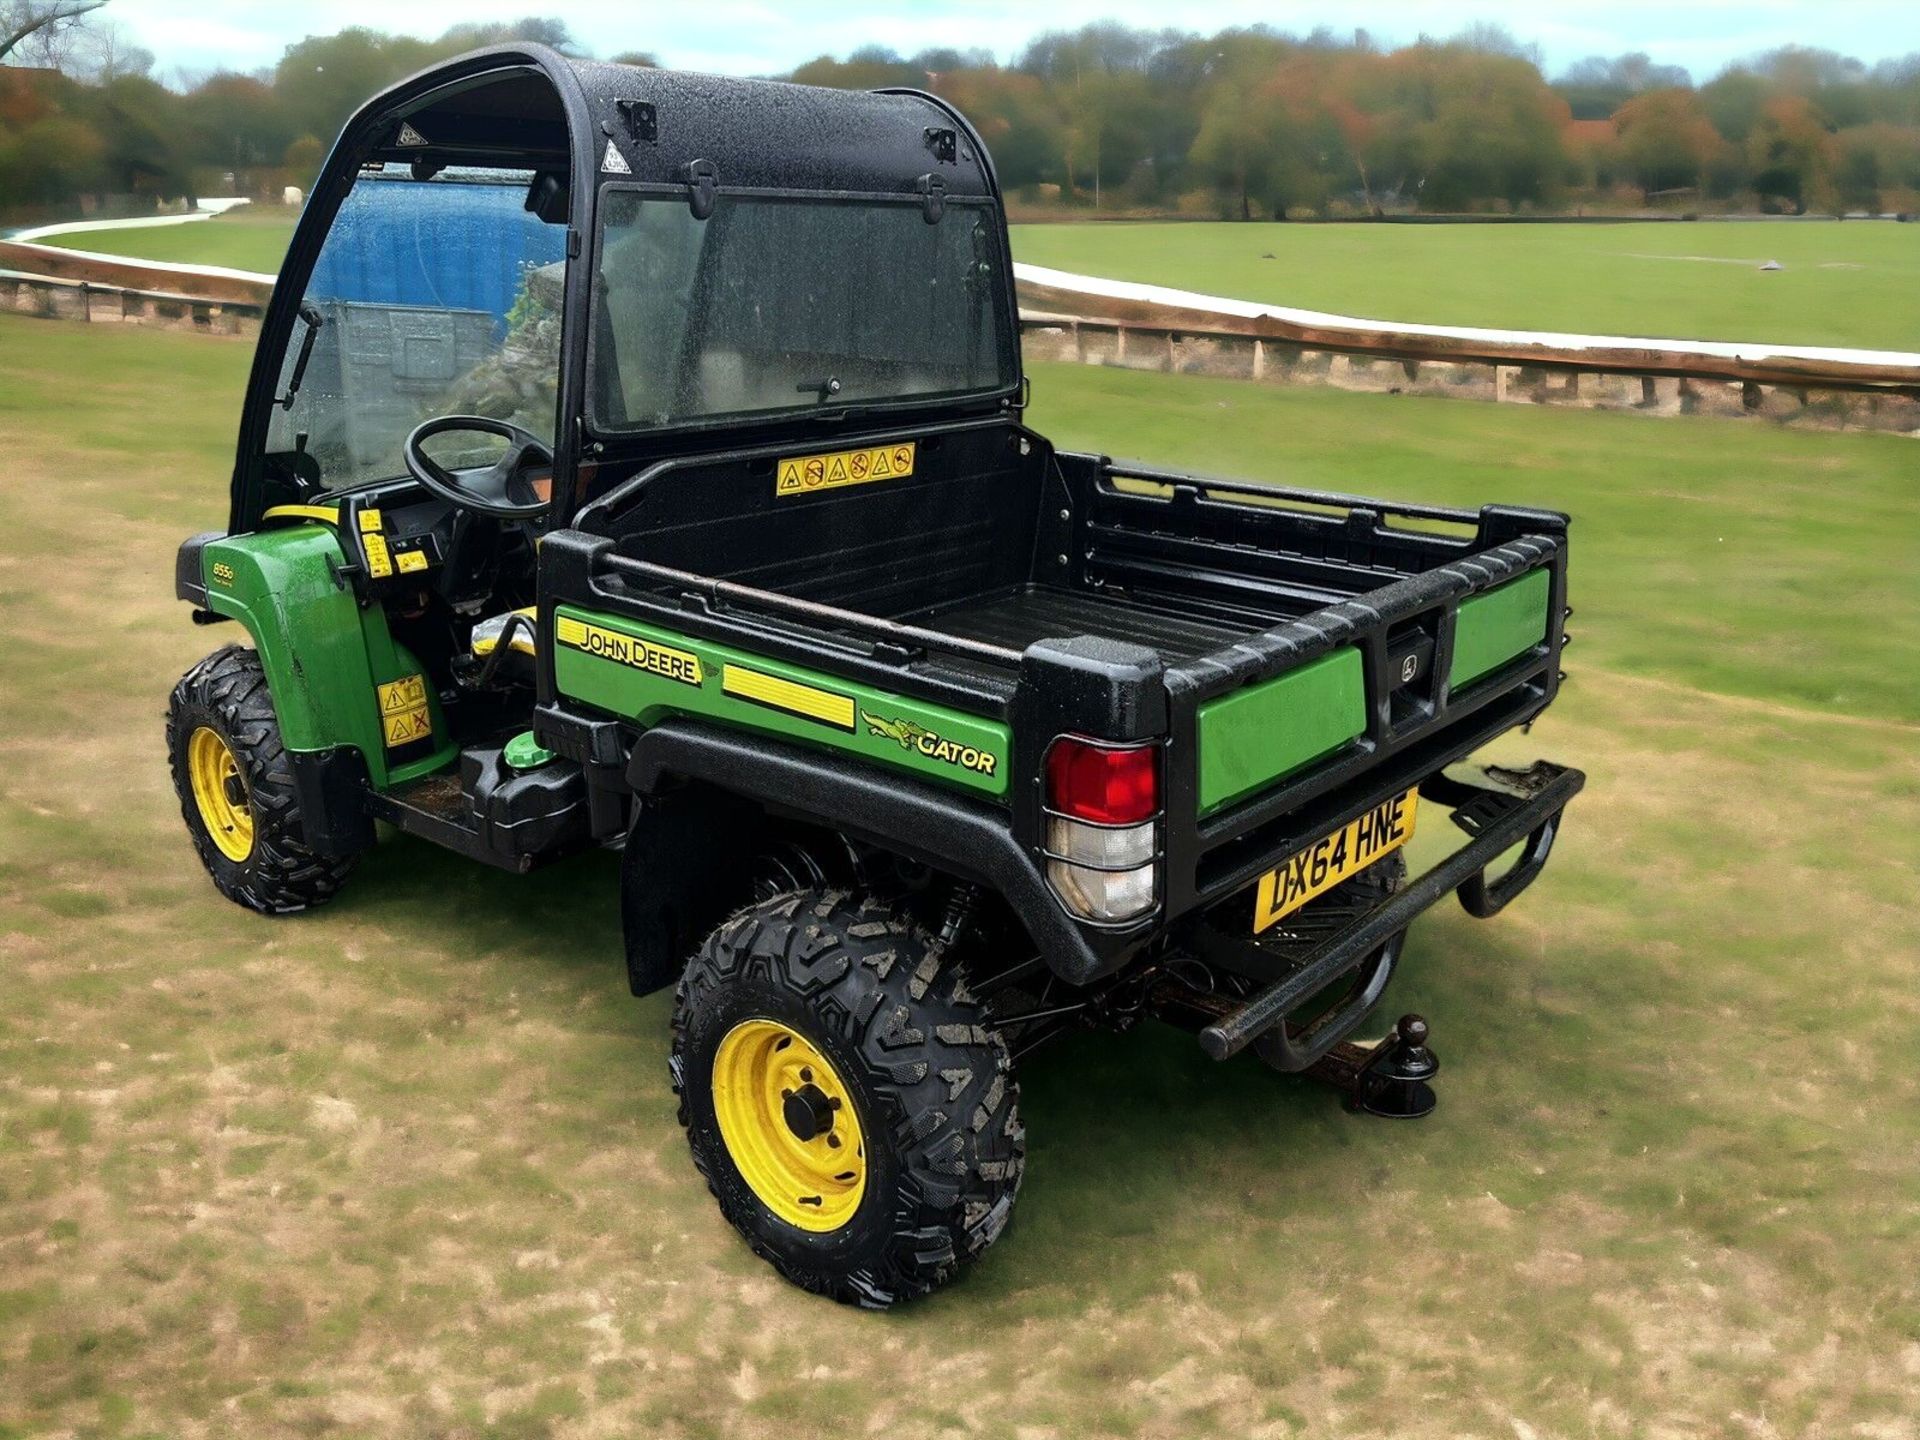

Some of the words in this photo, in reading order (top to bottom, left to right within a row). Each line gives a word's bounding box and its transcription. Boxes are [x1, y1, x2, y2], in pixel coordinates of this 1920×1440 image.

[580, 627, 628, 660] JOHN
[633, 641, 696, 680] DEERE
[916, 731, 996, 775] GATOR
[1270, 827, 1348, 915] DX64
[1355, 792, 1408, 864] HNE
